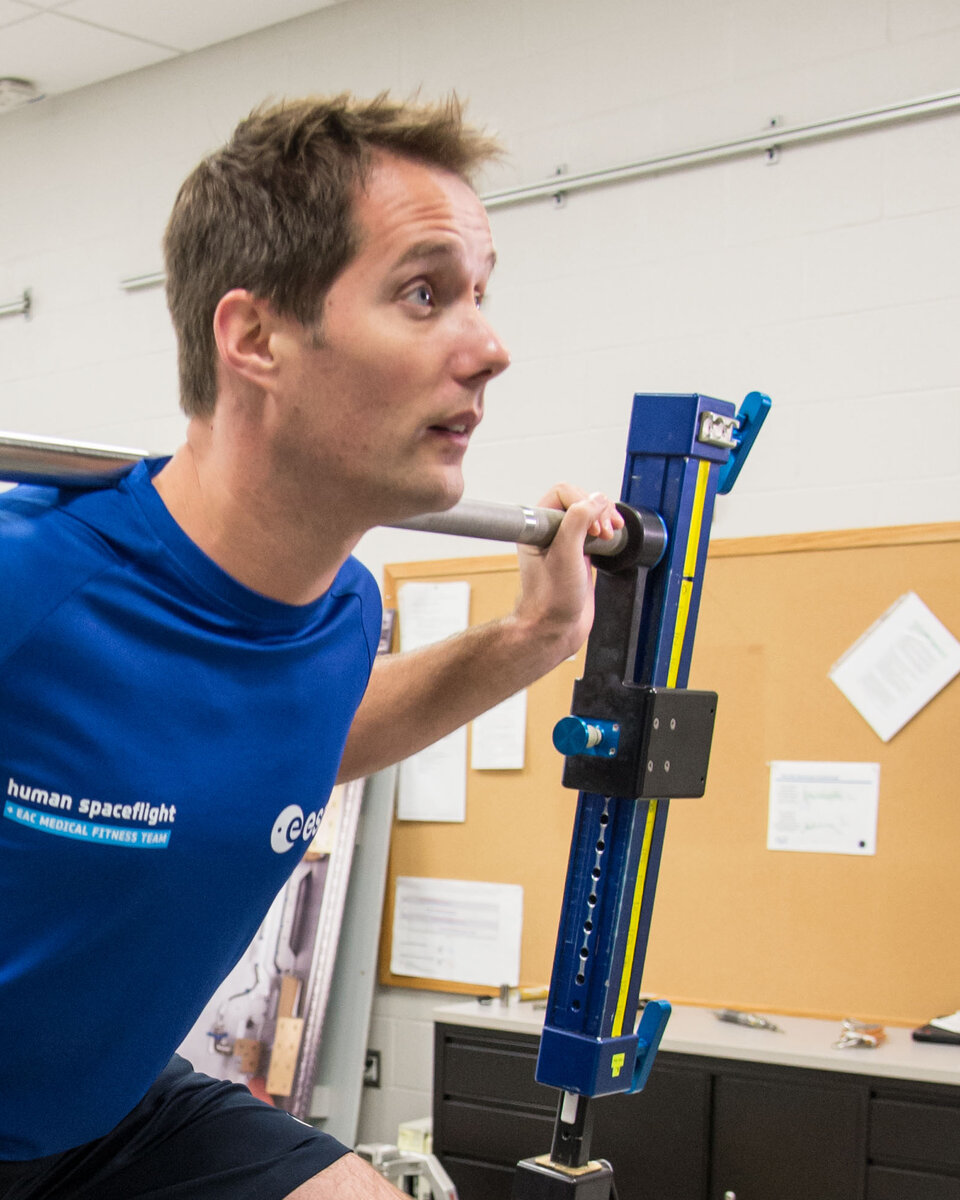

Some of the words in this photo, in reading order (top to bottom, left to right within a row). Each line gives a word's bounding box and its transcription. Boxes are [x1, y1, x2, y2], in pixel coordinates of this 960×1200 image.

[7, 777, 73, 811] human
[78, 798, 177, 826] spaceflight
[16, 808, 36, 824] EAC
[39, 816, 88, 837] MEDICAL
[92, 827, 138, 843] FITNESS
[141, 831, 168, 844] TEAM
